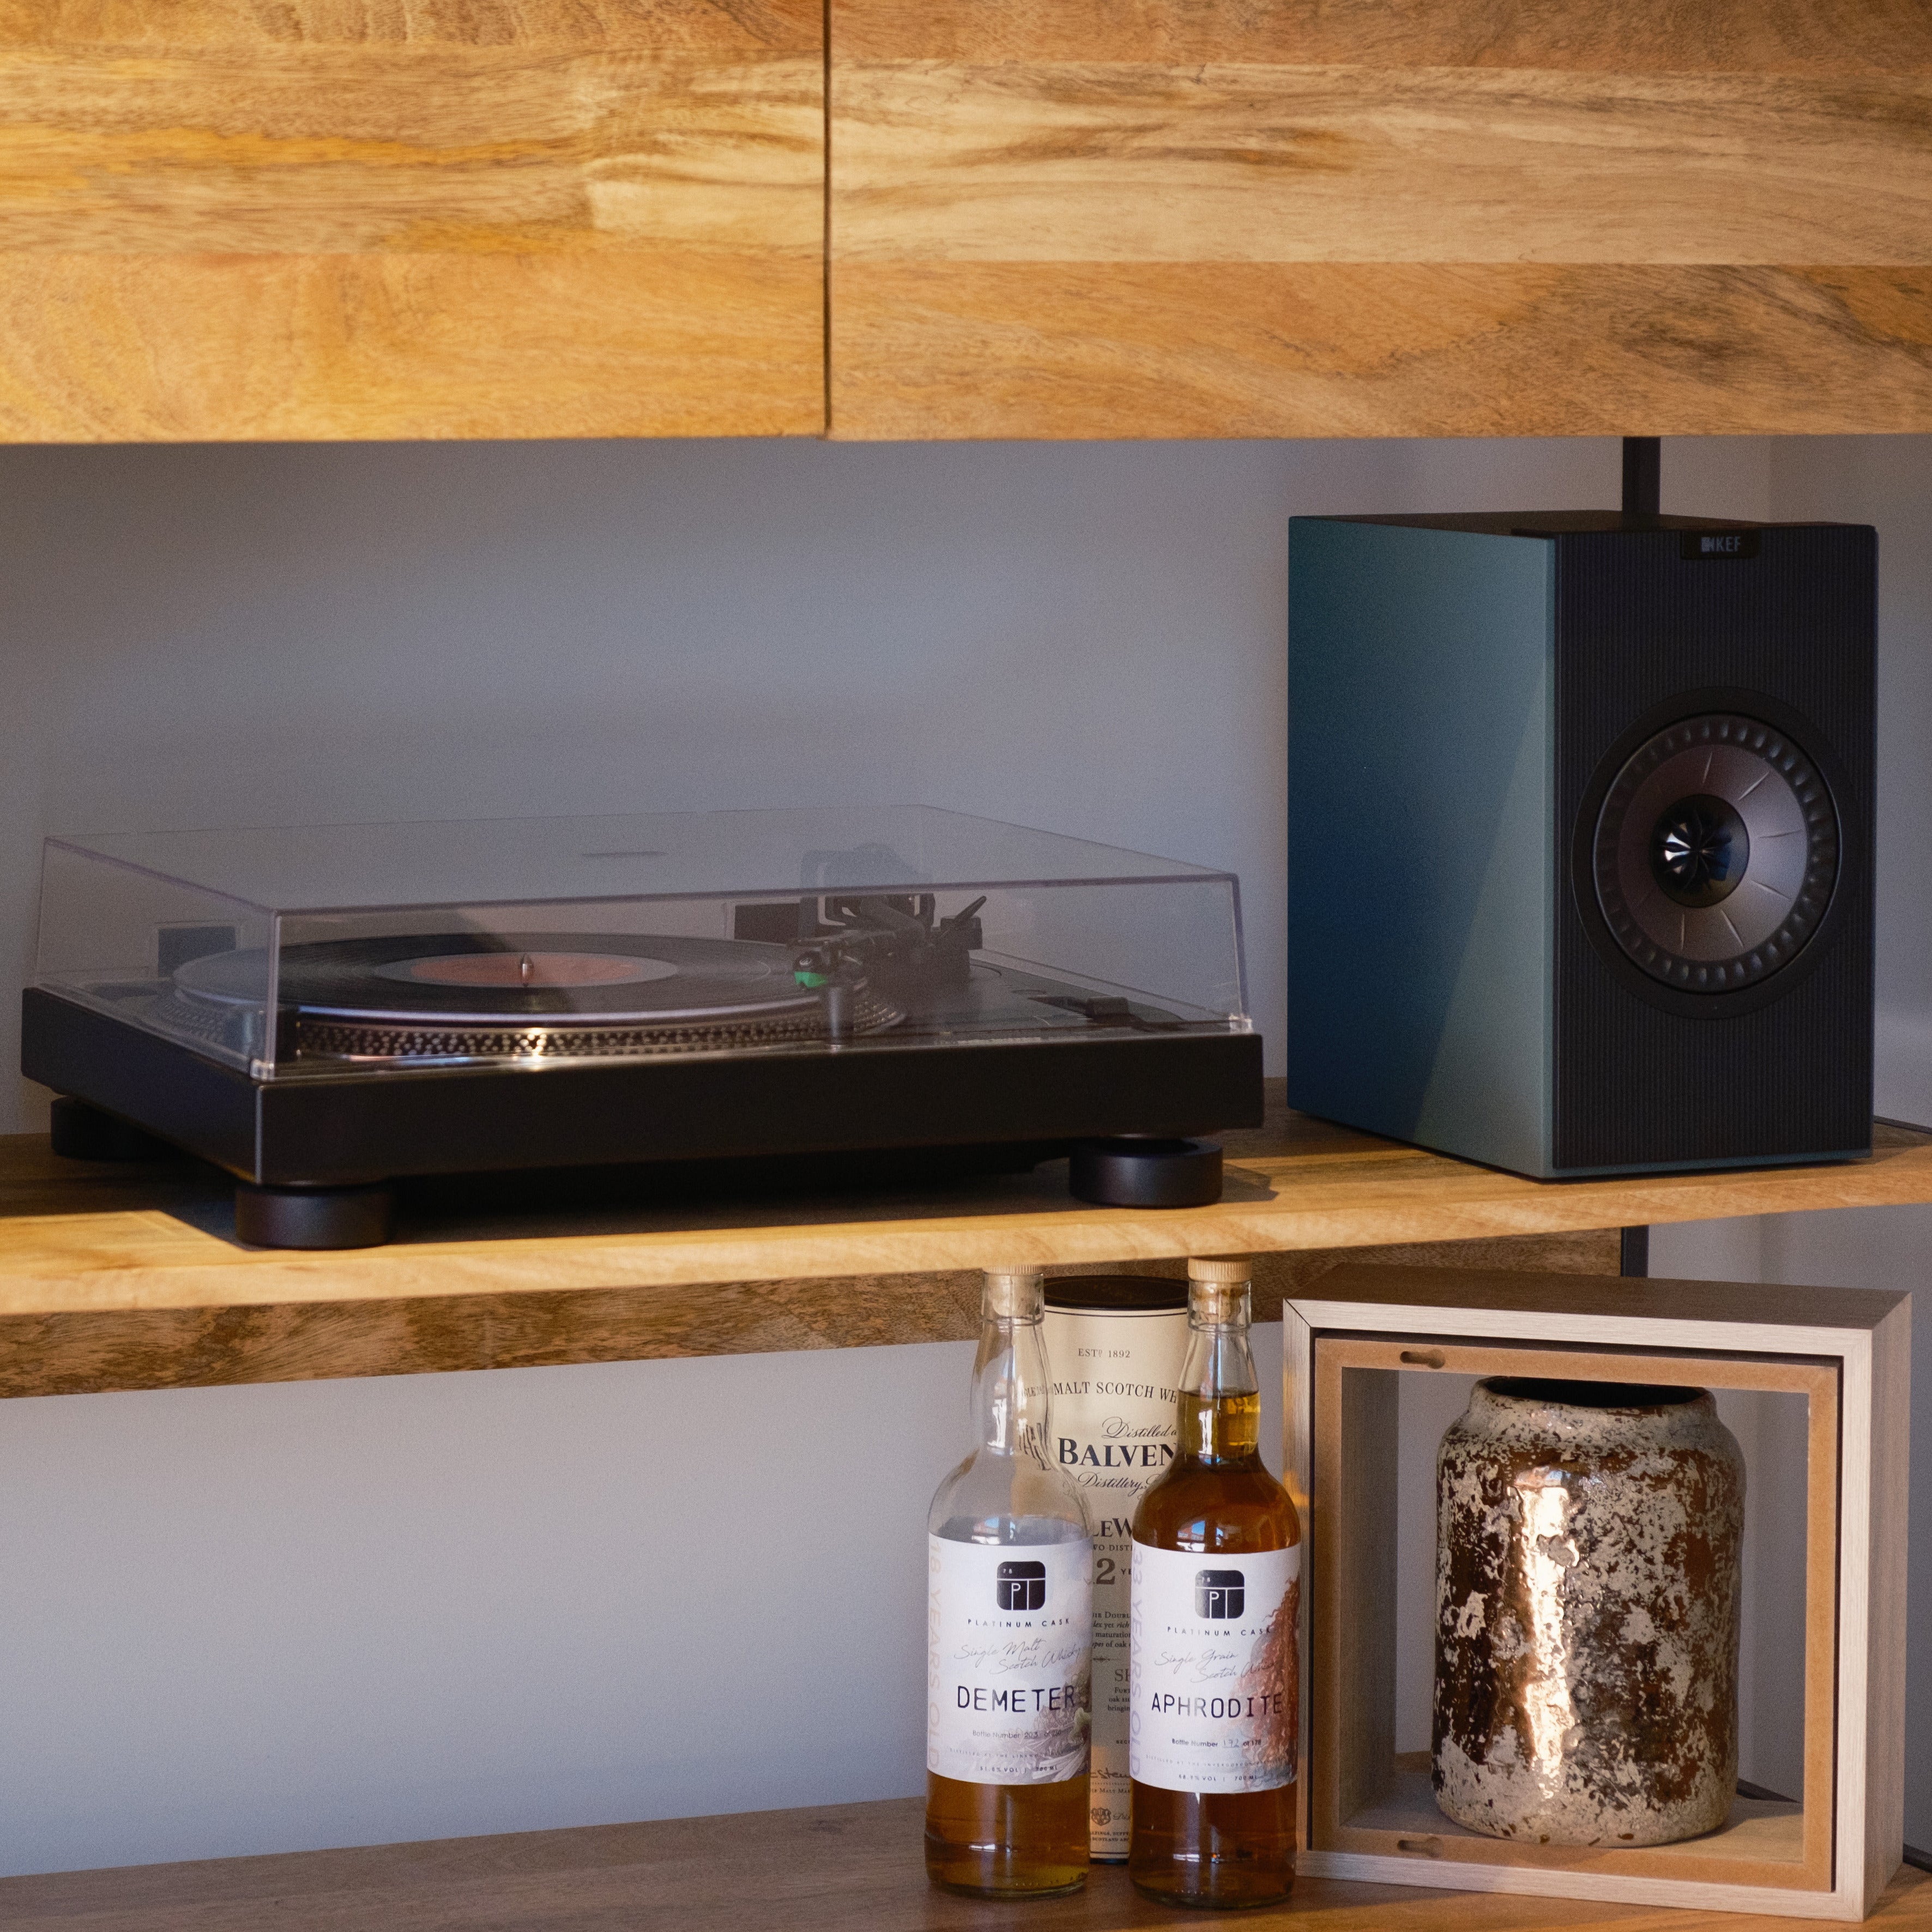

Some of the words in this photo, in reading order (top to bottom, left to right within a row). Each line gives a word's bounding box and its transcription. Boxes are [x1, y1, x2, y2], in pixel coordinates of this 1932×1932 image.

[1716, 536, 1741, 552] KEF
[1108, 1349, 1131, 1358] 1892
[1053, 1381, 1090, 1396] MALT
[1096, 1381, 1155, 1399] SCOTCH
[1102, 1416, 1172, 1439] Distilled
[1093, 1518, 1132, 1537] EW
[1093, 1557, 1115, 1585] 2
[968, 1619, 1032, 1628] PLATINUM
[1042, 1618, 1070, 1627] CASK
[1167, 1626, 1230, 1636] PLATINUM
[1241, 1626, 1270, 1636] CASK
[954, 1644, 999, 1668] Single
[1003, 1637, 1047, 1661] Malt
[1132, 1599, 1143, 1698] YEARS
[989, 1655, 1039, 1675] Scotch
[1155, 1651, 1196, 1674] Single
[1196, 1649, 1239, 1670] Grain
[1191, 1665, 1238, 1683] Scotch
[957, 1685, 1075, 1713] DEMETER
[1151, 1692, 1282, 1718] APHRODITE
[1131, 1710, 1142, 1776] OLD
